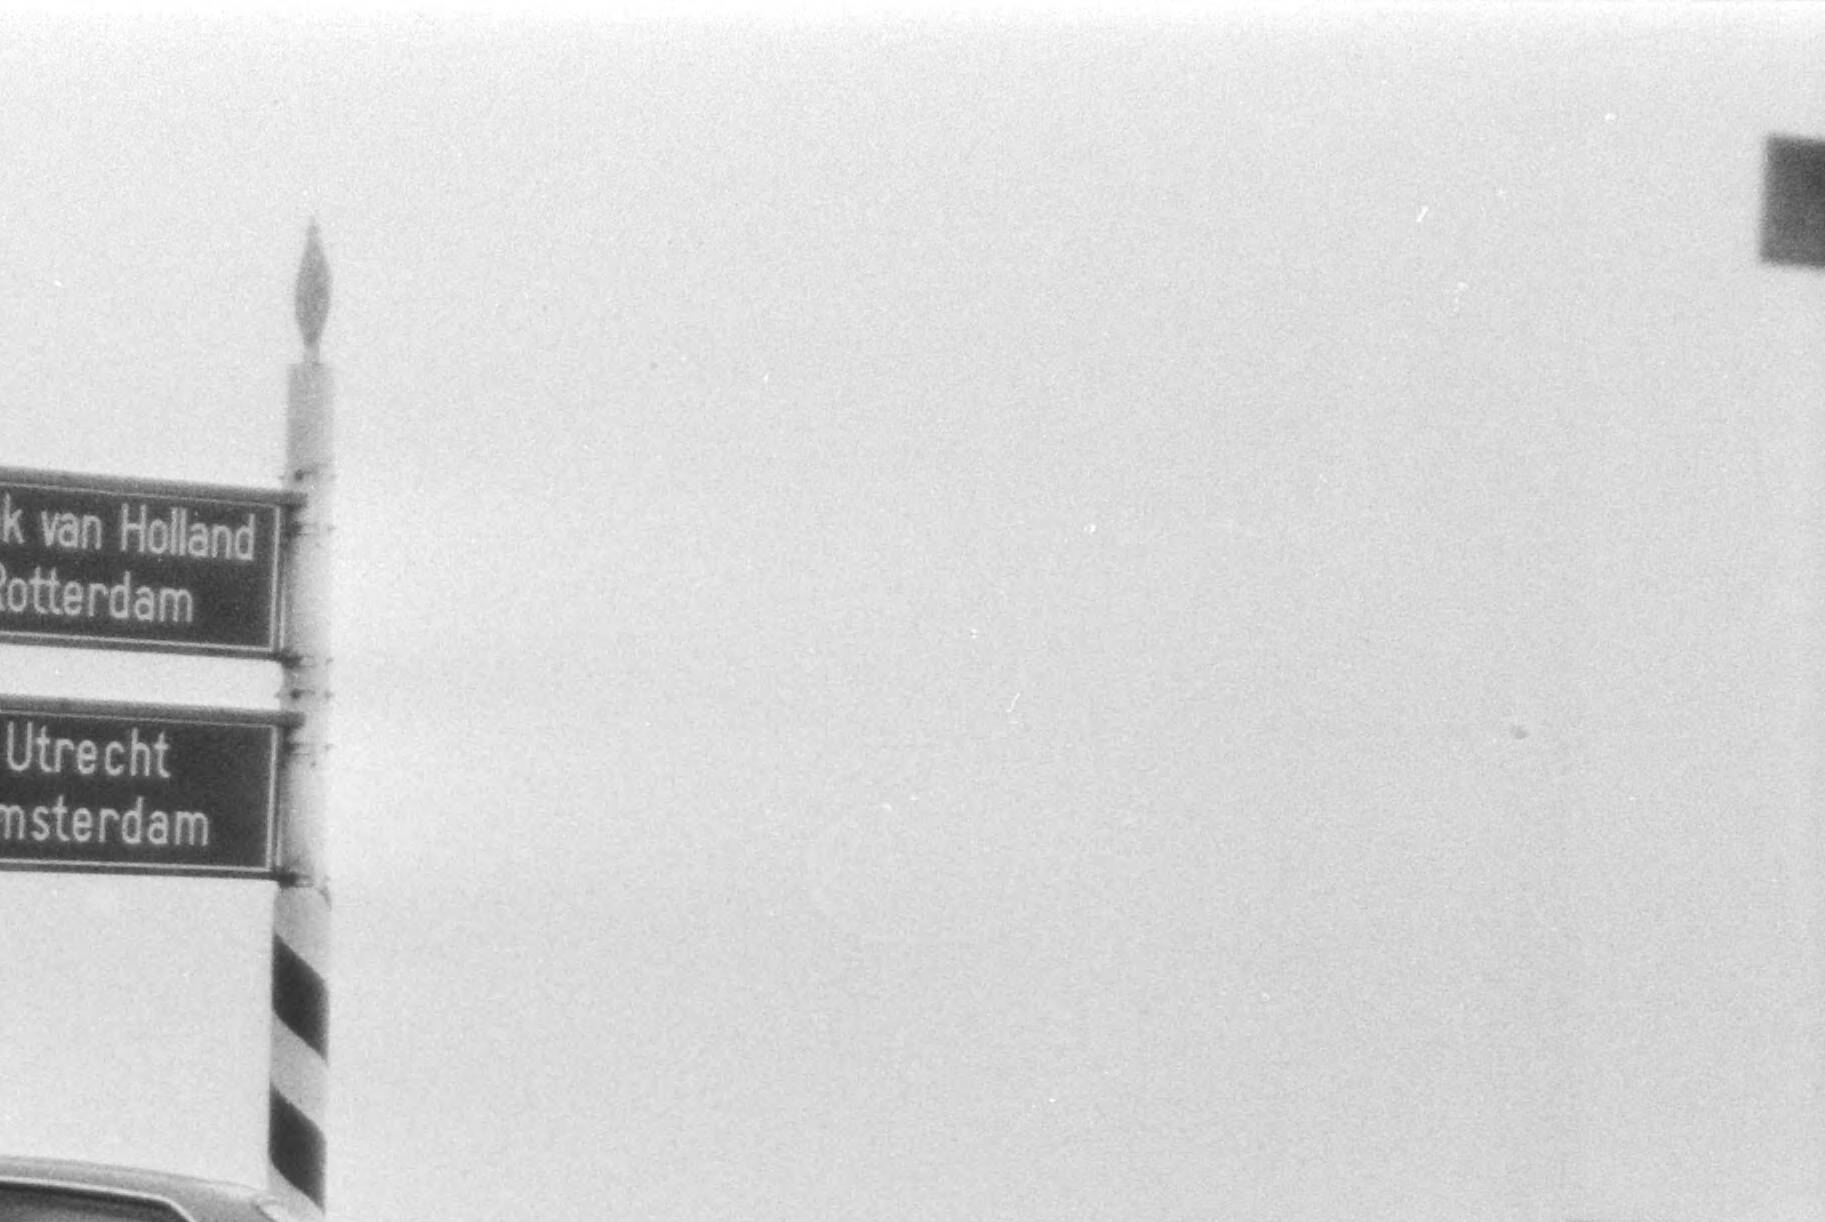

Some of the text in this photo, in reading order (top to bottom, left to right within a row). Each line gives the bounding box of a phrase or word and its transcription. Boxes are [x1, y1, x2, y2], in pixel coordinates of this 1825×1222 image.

[42, 510, 103, 550] van
[120, 503, 256, 561] Holland
[5, 720, 171, 778] Utrecht
